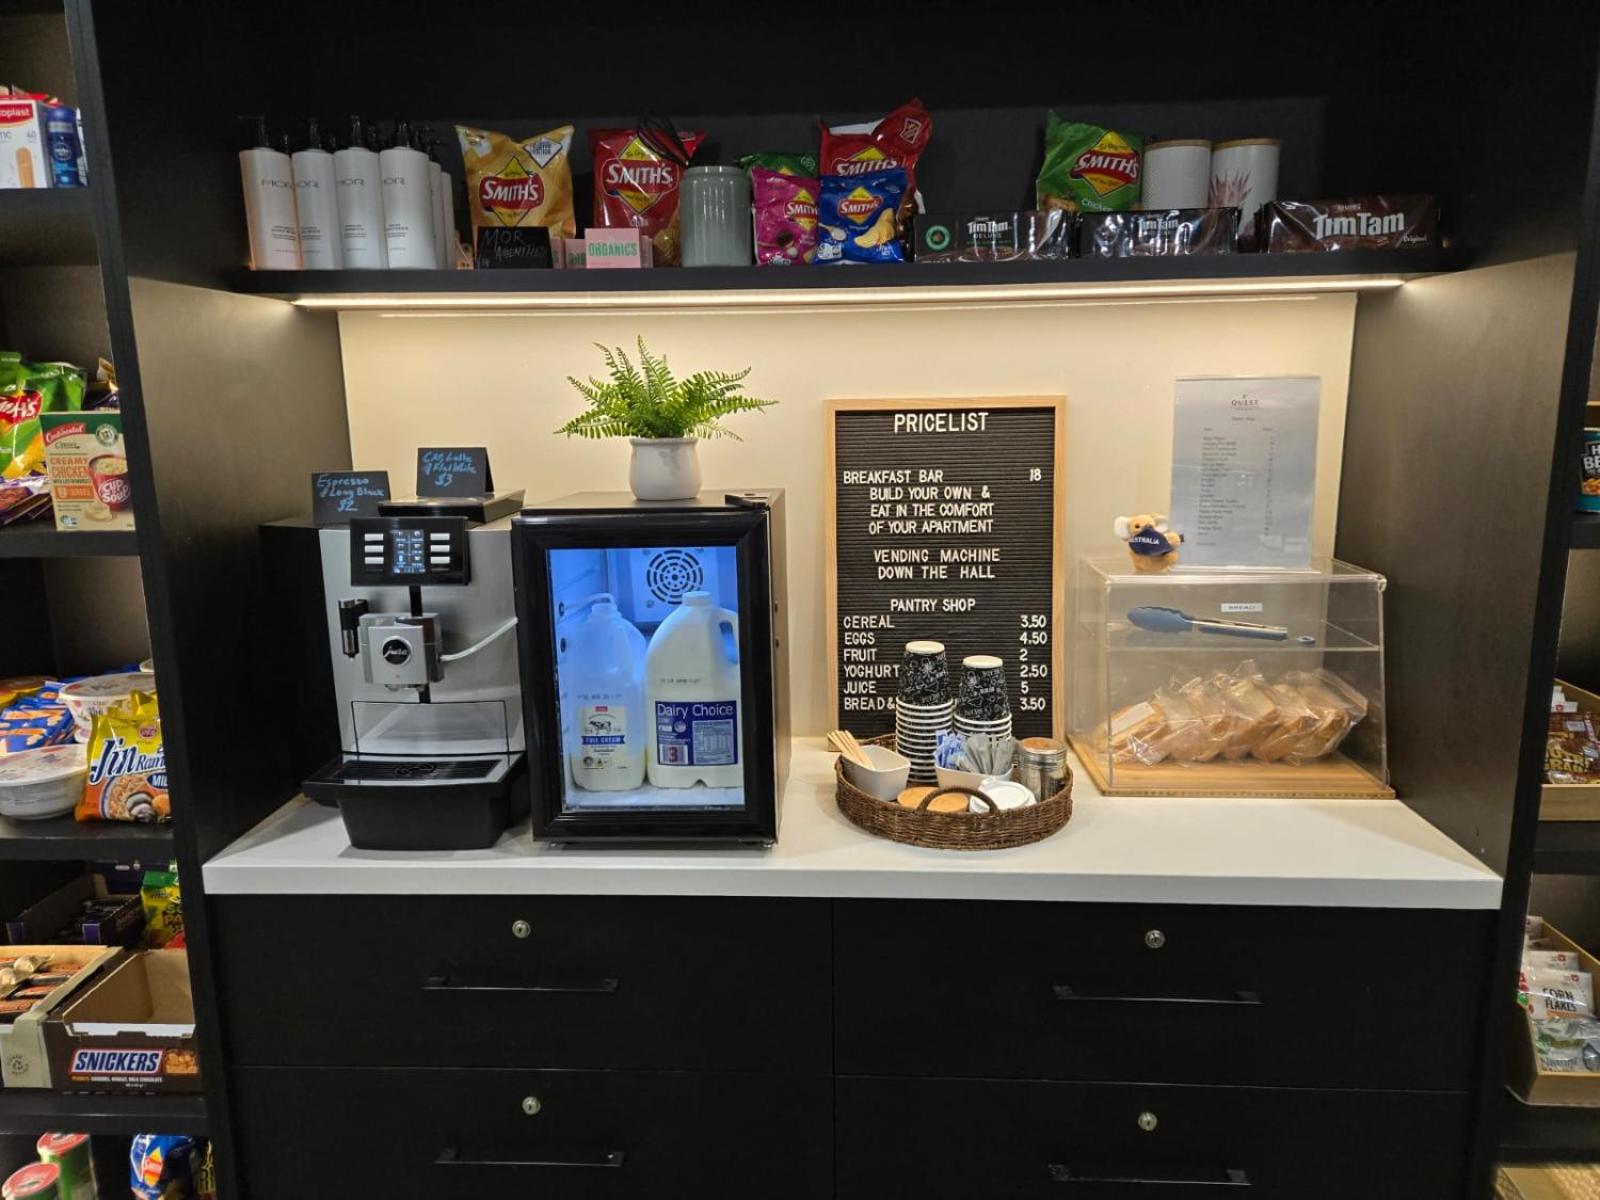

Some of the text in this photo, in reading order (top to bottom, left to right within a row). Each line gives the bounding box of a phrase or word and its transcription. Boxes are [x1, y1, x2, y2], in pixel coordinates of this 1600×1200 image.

[1078, 153, 1139, 178] SMITH'S
[383, 177, 406, 185] OR
[606, 163, 673, 185] SMITH'S
[297, 180, 320, 188] OR
[482, 180, 539, 202] SMITH'S
[588, 242, 638, 257] ORGANICS
[893, 412, 989, 433] PRICELIST
[843, 468, 1042, 484] BREAKFAST BAR 18
[869, 485, 991, 501] BUILD YOUR OWN &
[870, 502, 994, 517] EAT IN THE COMFORT
[868, 519, 994, 535] OF YOUR APARTMENT
[873, 548, 1000, 563] VENDING MACHINE
[878, 565, 996, 580] DOWN THE HALL
[890, 598, 976, 612] PANTRY SHOP
[843, 615, 1047, 629] CEREAL 3.50
[844, 632, 1048, 645] EGGS 4.50
[843, 649, 1028, 662] FRUIT 2
[843, 665, 1048, 678] YOGHURT 2.50
[843, 681, 1029, 694] JUICE 5
[657, 703, 734, 719] Dairy Choice
[1020, 697, 1046, 710] 3.50
[151, 775, 168, 786] MIL
[1545, 1000, 1577, 1012] FLAKES
[75, 1052, 159, 1072] SNICKERS
